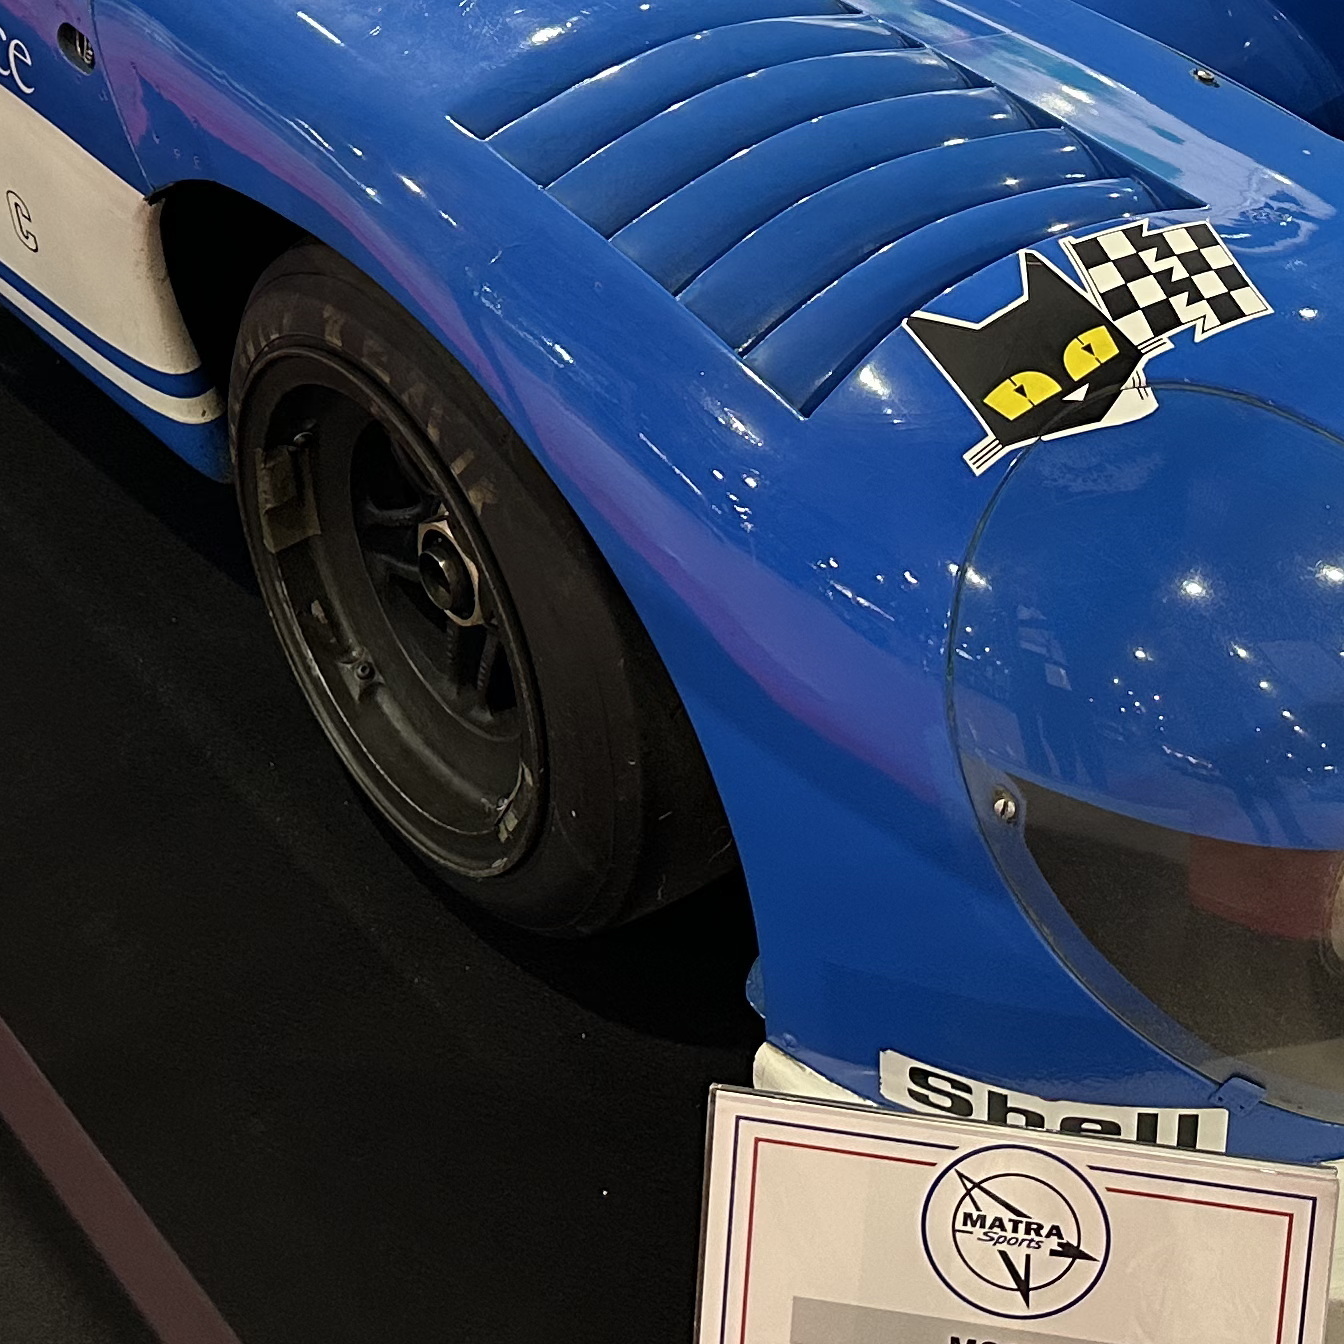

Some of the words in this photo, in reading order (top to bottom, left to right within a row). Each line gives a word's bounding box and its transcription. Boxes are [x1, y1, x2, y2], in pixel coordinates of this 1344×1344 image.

[6, 189, 39, 253] C
[961, 1211, 1065, 1241] MATRA
[976, 1230, 1045, 1250] Sports
